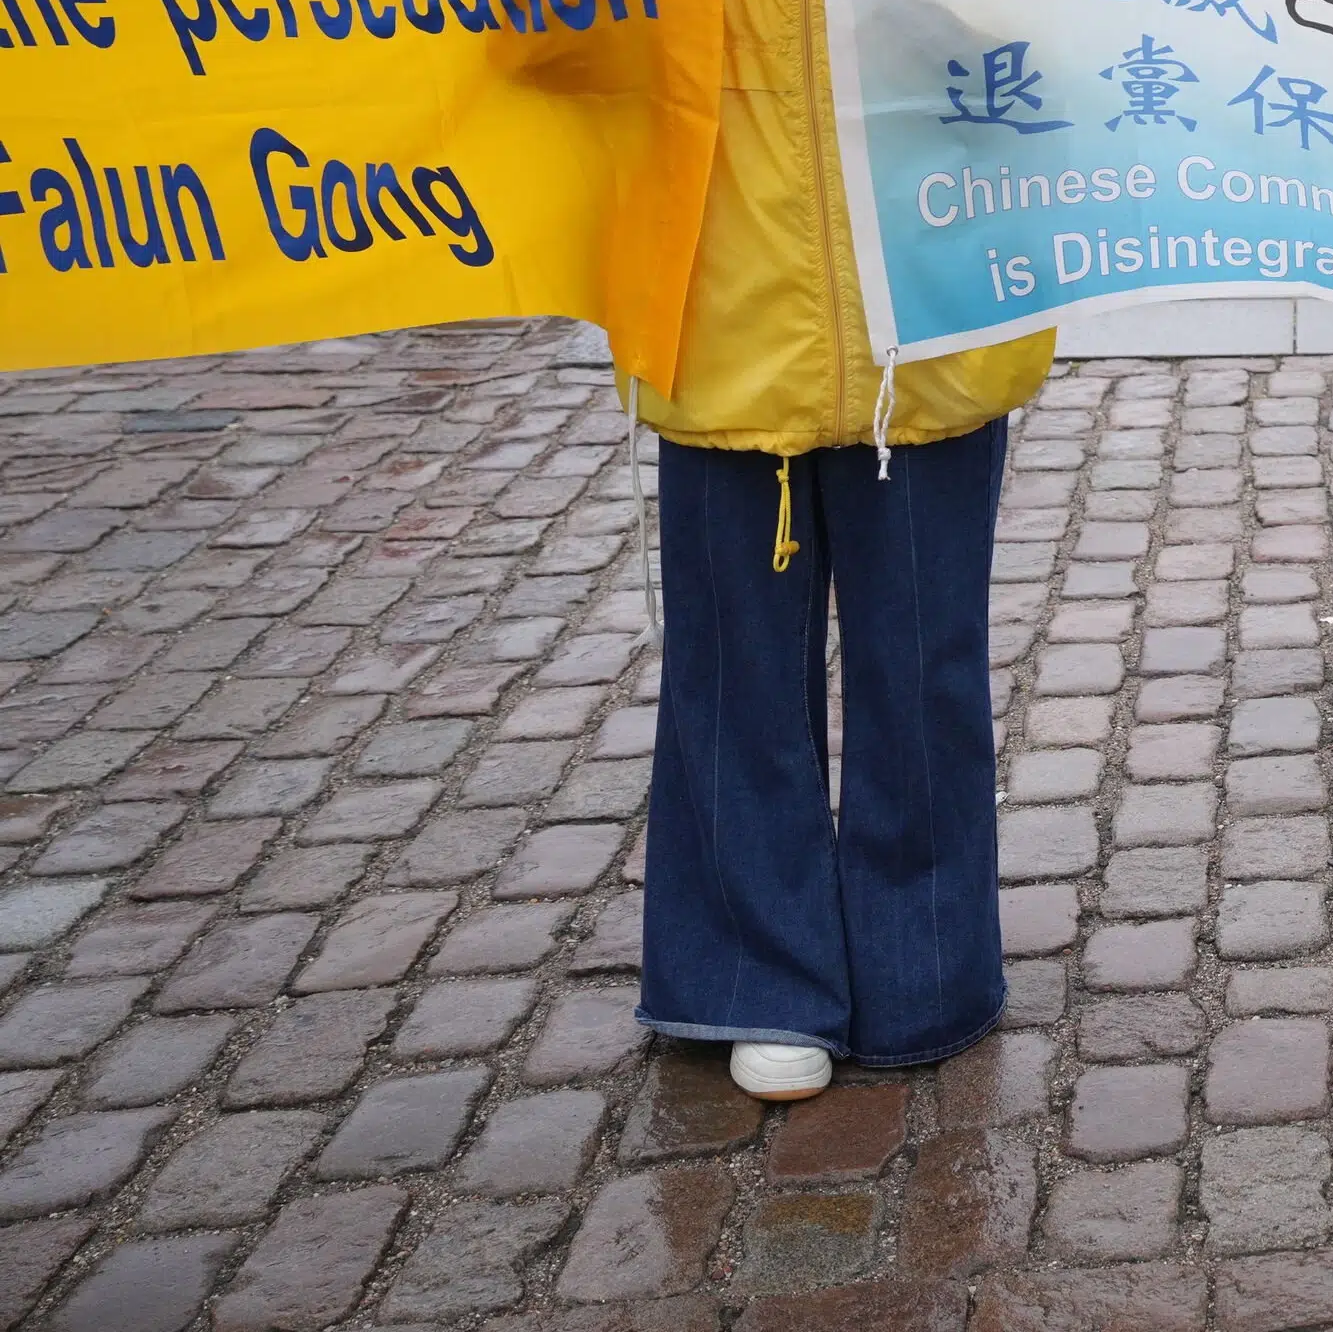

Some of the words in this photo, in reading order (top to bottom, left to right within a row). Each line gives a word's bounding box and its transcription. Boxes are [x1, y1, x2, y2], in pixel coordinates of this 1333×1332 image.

[0, 139, 225, 273] alun
[249, 128, 493, 267] Gong
[917, 163, 1157, 228] Chinese
[986, 247, 1038, 303] is
